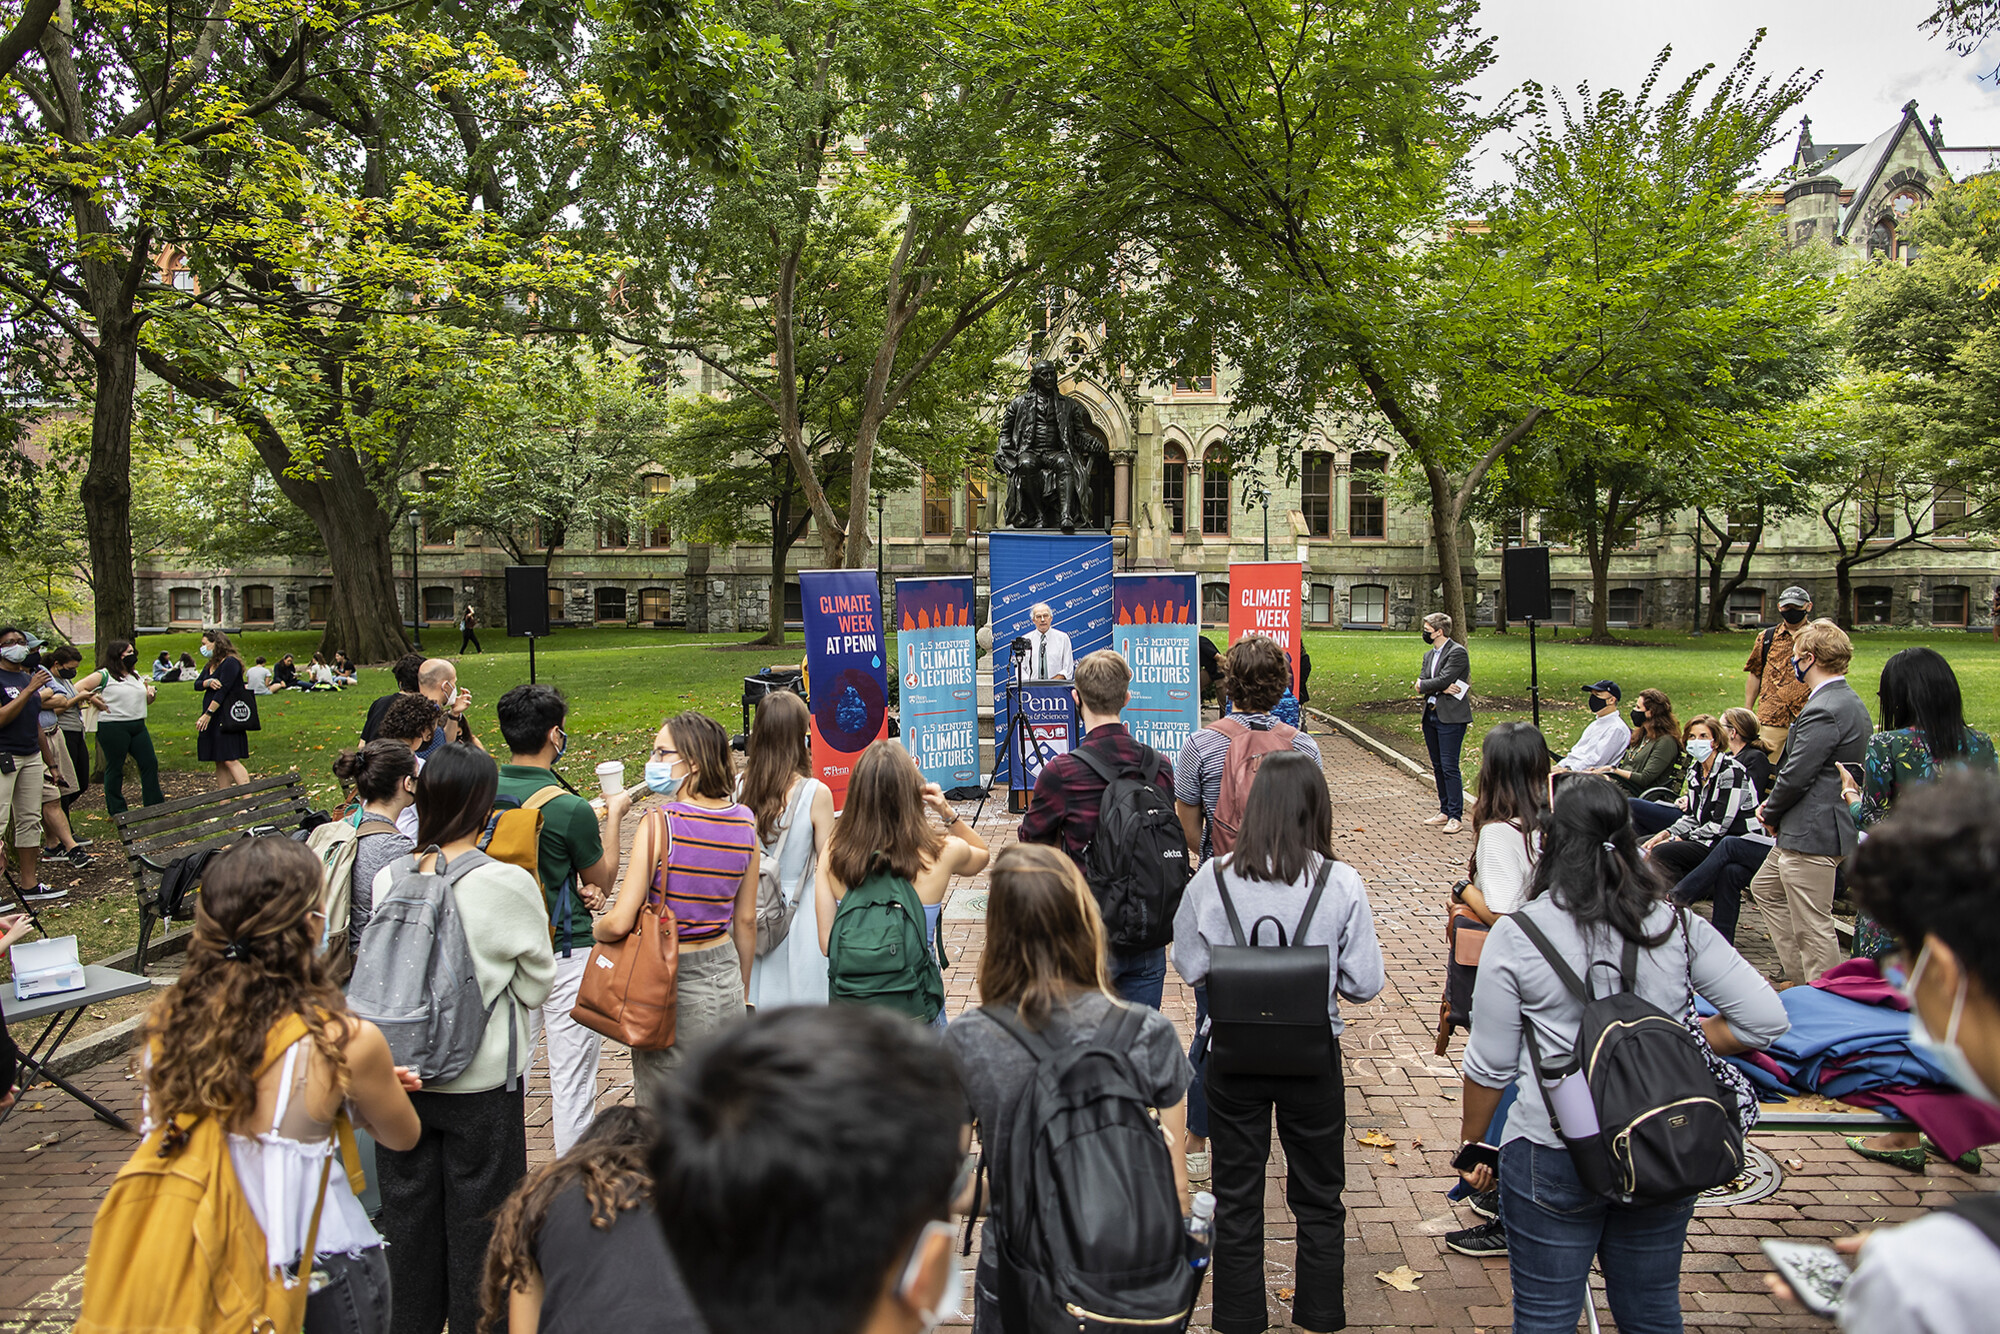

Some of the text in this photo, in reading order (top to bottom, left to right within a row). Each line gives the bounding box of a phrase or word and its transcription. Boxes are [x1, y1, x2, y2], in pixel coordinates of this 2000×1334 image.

[820, 594, 872, 614] CLIMATE
[1242, 588, 1291, 607] CLIMATE
[838, 614, 874, 633] WEEK
[1256, 609, 1290, 627] WEEK
[826, 634, 876, 655] AT PENN
[935, 640, 970, 650] MINUTE
[1151, 638, 1190, 647] MINUTE
[920, 648, 971, 670] CLIMATE
[1135, 646, 1190, 666] CLIMATE
[921, 668, 972, 688] LECTURES
[1136, 666, 1190, 684] LECTURES
[1018, 691, 1068, 711] Penn
[1041, 712, 1069, 720] Sciences
[938, 721, 973, 732] MINUTE
[1152, 721, 1190, 731] MINUTE
[922, 729, 974, 752] CLIMATE
[923, 749, 974, 770] LECTURES
[831, 766, 849, 776] Penn
[1163, 850, 1182, 858] okta
